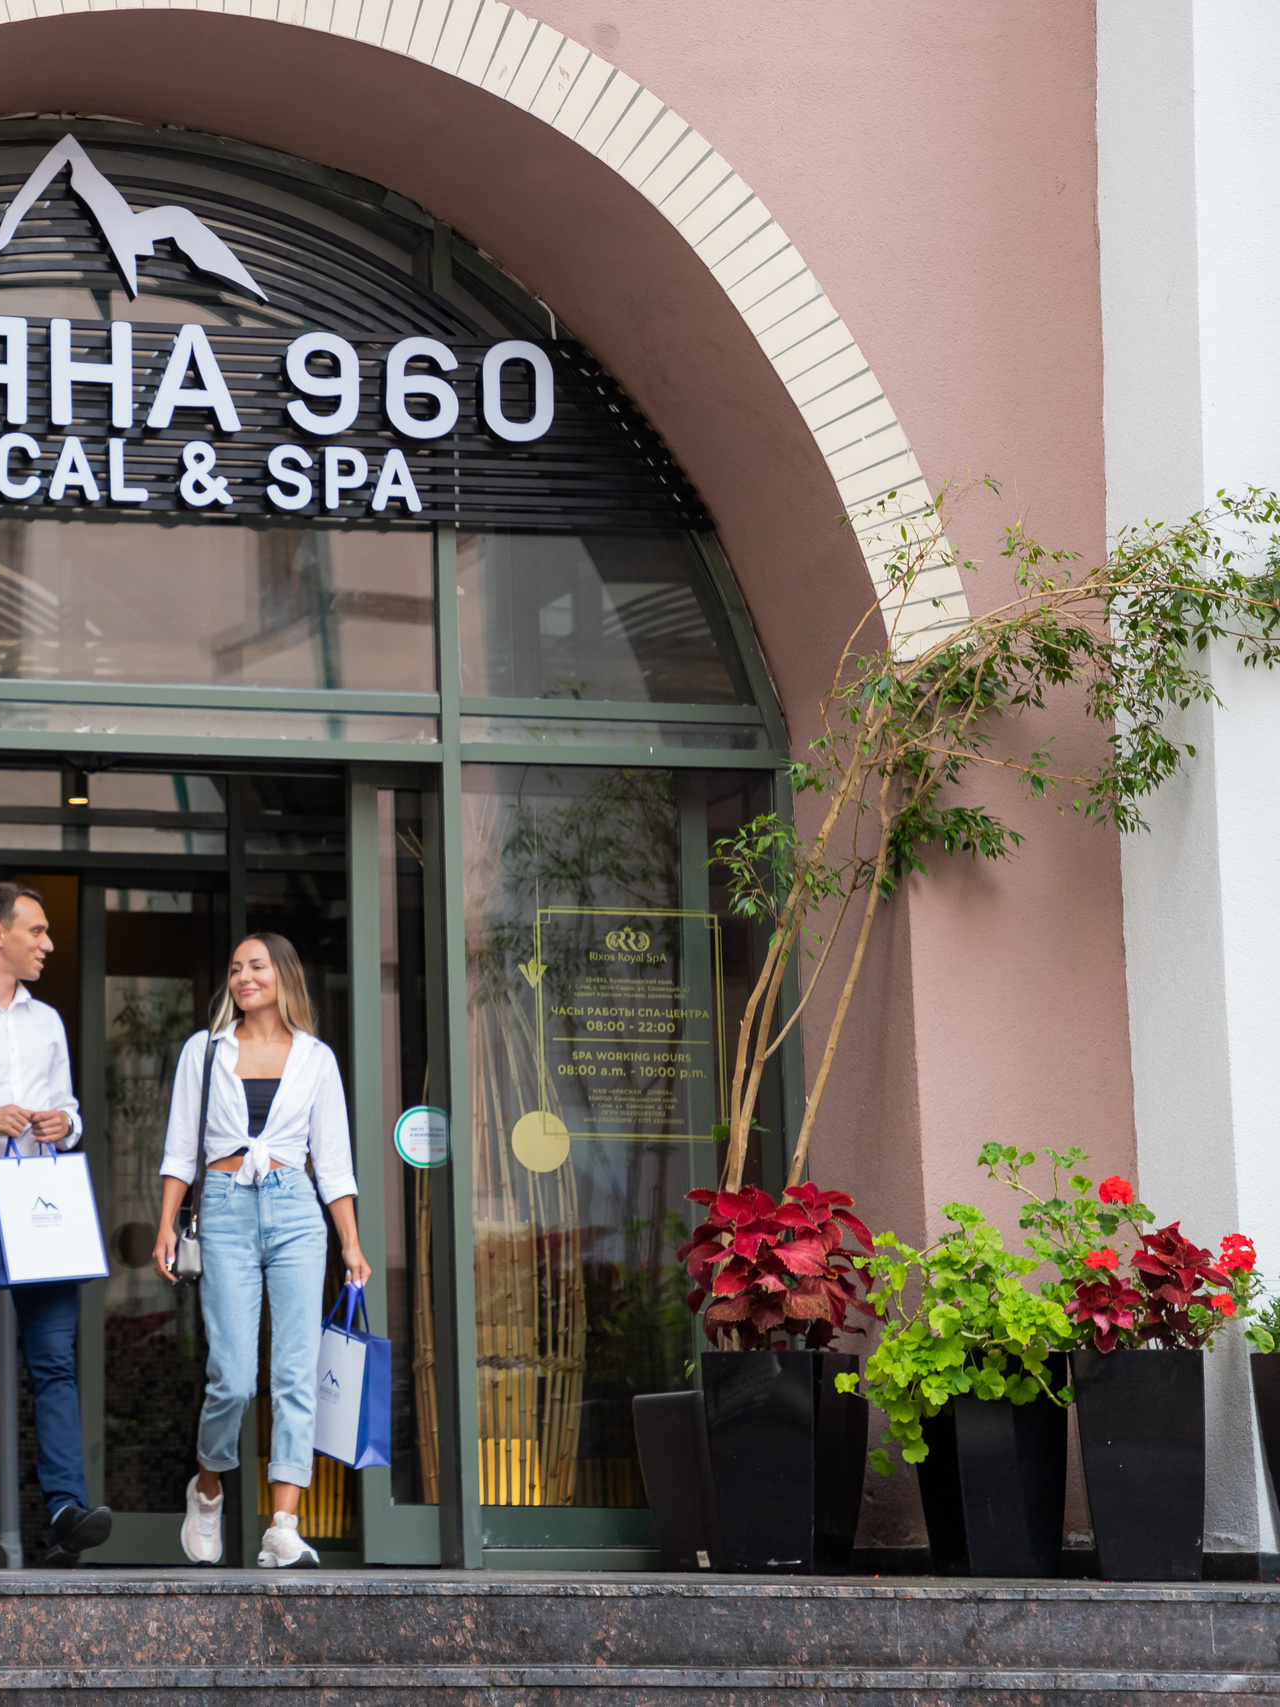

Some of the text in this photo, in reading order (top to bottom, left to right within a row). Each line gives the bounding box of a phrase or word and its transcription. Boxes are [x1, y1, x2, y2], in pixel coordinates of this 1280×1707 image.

[283, 331, 555, 445] 960
[179, 440, 234, 508] &
[266, 444, 424, 515] SPA
[589, 951, 667, 965] Rixos Royal SpA
[550, 1006, 710, 1019] ЧАСЫ РАБОТЫ СПА-ЦЕНТРА
[586, 1020, 625, 1032] 08:00
[638, 1022, 676, 1033] 22:00
[572, 1051, 692, 1063] SPA WORKING HOURS
[558, 1064, 596, 1076] 08:00
[600, 1067, 626, 1077] a.m.
[640, 1066, 676, 1078] 10:00
[680, 1069, 708, 1080] p.m.
